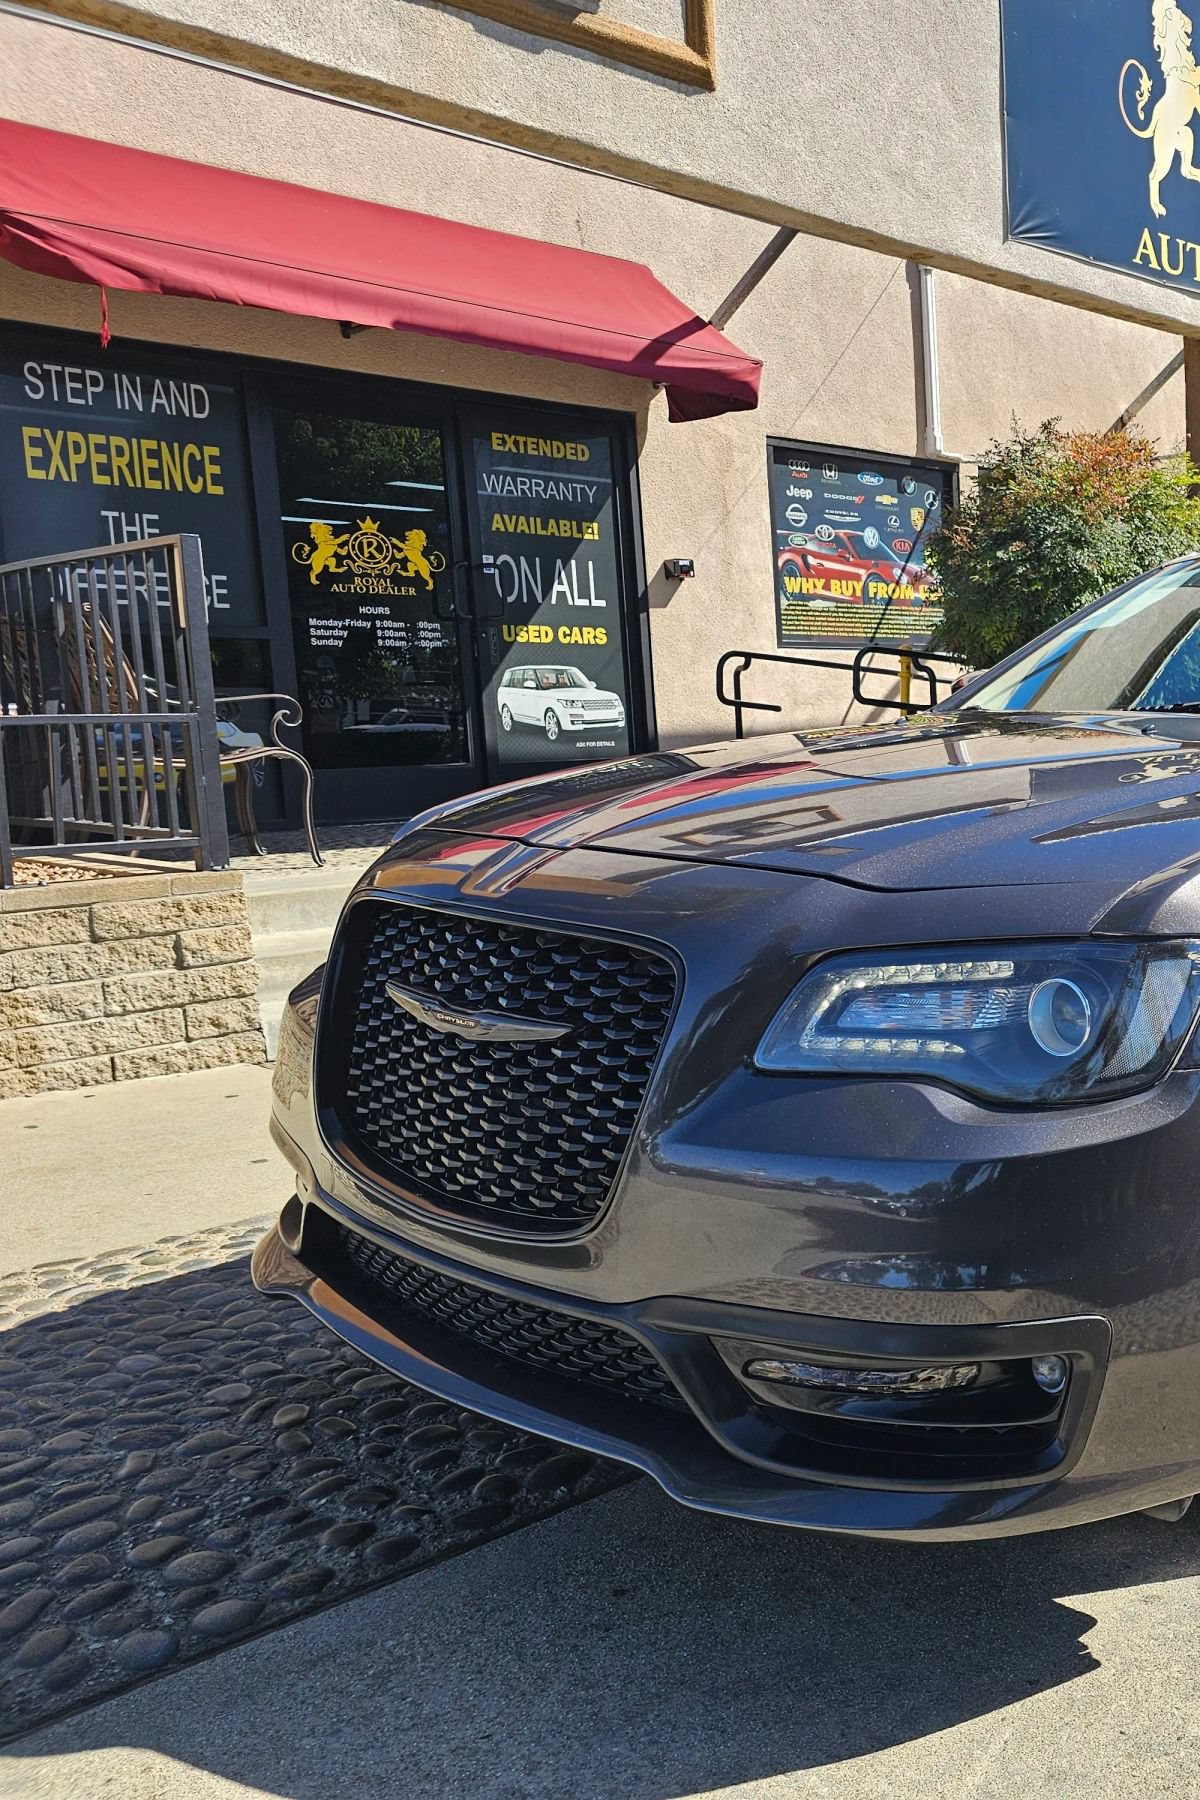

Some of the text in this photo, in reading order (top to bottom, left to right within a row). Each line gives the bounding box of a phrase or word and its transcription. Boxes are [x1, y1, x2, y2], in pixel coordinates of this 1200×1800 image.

[23, 361, 210, 419] STEP IN AND
[491, 431, 590, 462] EXTENDED
[22, 426, 225, 496] EXPERIENCE
[791, 471, 808, 479] Audi
[482, 473, 598, 504] WARRANTY
[786, 484, 813, 500] Jeep
[101, 510, 160, 546] THE
[491, 513, 600, 541] AVAILABLE!
[361, 537, 382, 559] R
[895, 541, 910, 549] KIA
[330, 583, 417, 596] AUTO DEALER
[354, 576, 394, 587] ROYAL
[494, 554, 607, 608] ON ALL
[784, 576, 826, 595] WHY
[831, 579, 863, 597] BUY
[868, 581, 915, 600] FROM
[359, 606, 391, 615] HOURS
[308, 618, 372, 630] Monday-Friday
[375, 620, 405, 628] 9:00am
[309, 628, 348, 638] Saturday
[376, 629, 407, 637] 9:00am
[310, 637, 344, 648] Sunday
[377, 639, 407, 647] 9:00am
[502, 624, 608, 645] USED CARS
[437, 1013, 475, 1027] CHRYSLER
